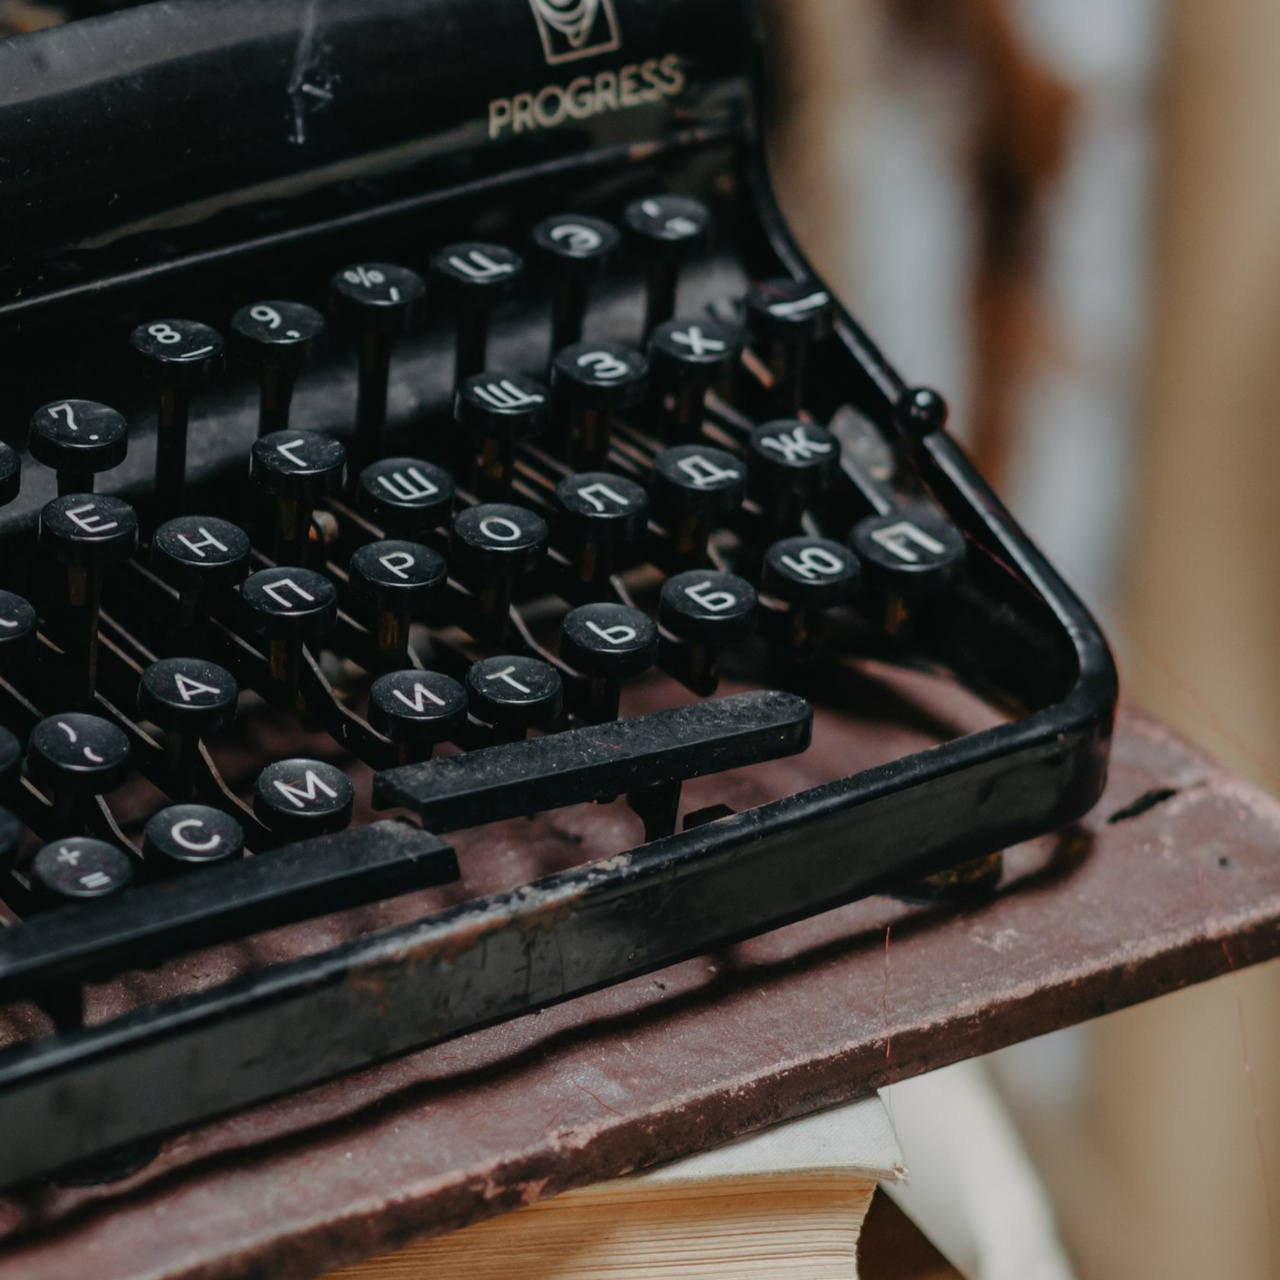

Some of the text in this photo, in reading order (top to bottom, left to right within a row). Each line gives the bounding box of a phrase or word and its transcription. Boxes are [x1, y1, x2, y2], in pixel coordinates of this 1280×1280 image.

[488, 53, 686, 140] PROGRESS
[250, 305, 282, 329] 9
[147, 323, 182, 344] 8
[48, 403, 78, 431] 7
[277, 439, 308, 467] Г
[760, 426, 832, 462] Ж
[377, 467, 439, 501] Ш
[677, 454, 741, 487] Д
[576, 483, 630, 512] Л
[65, 503, 119, 533] Е
[177, 527, 229, 557] Н
[781, 546, 845, 579] Ю
[262, 578, 315, 608] П
[684, 580, 738, 612] Б
[174, 673, 221, 702] А
[485, 666, 531, 694] Т
[392, 683, 446, 713] И
[273, 770, 338, 808] М
